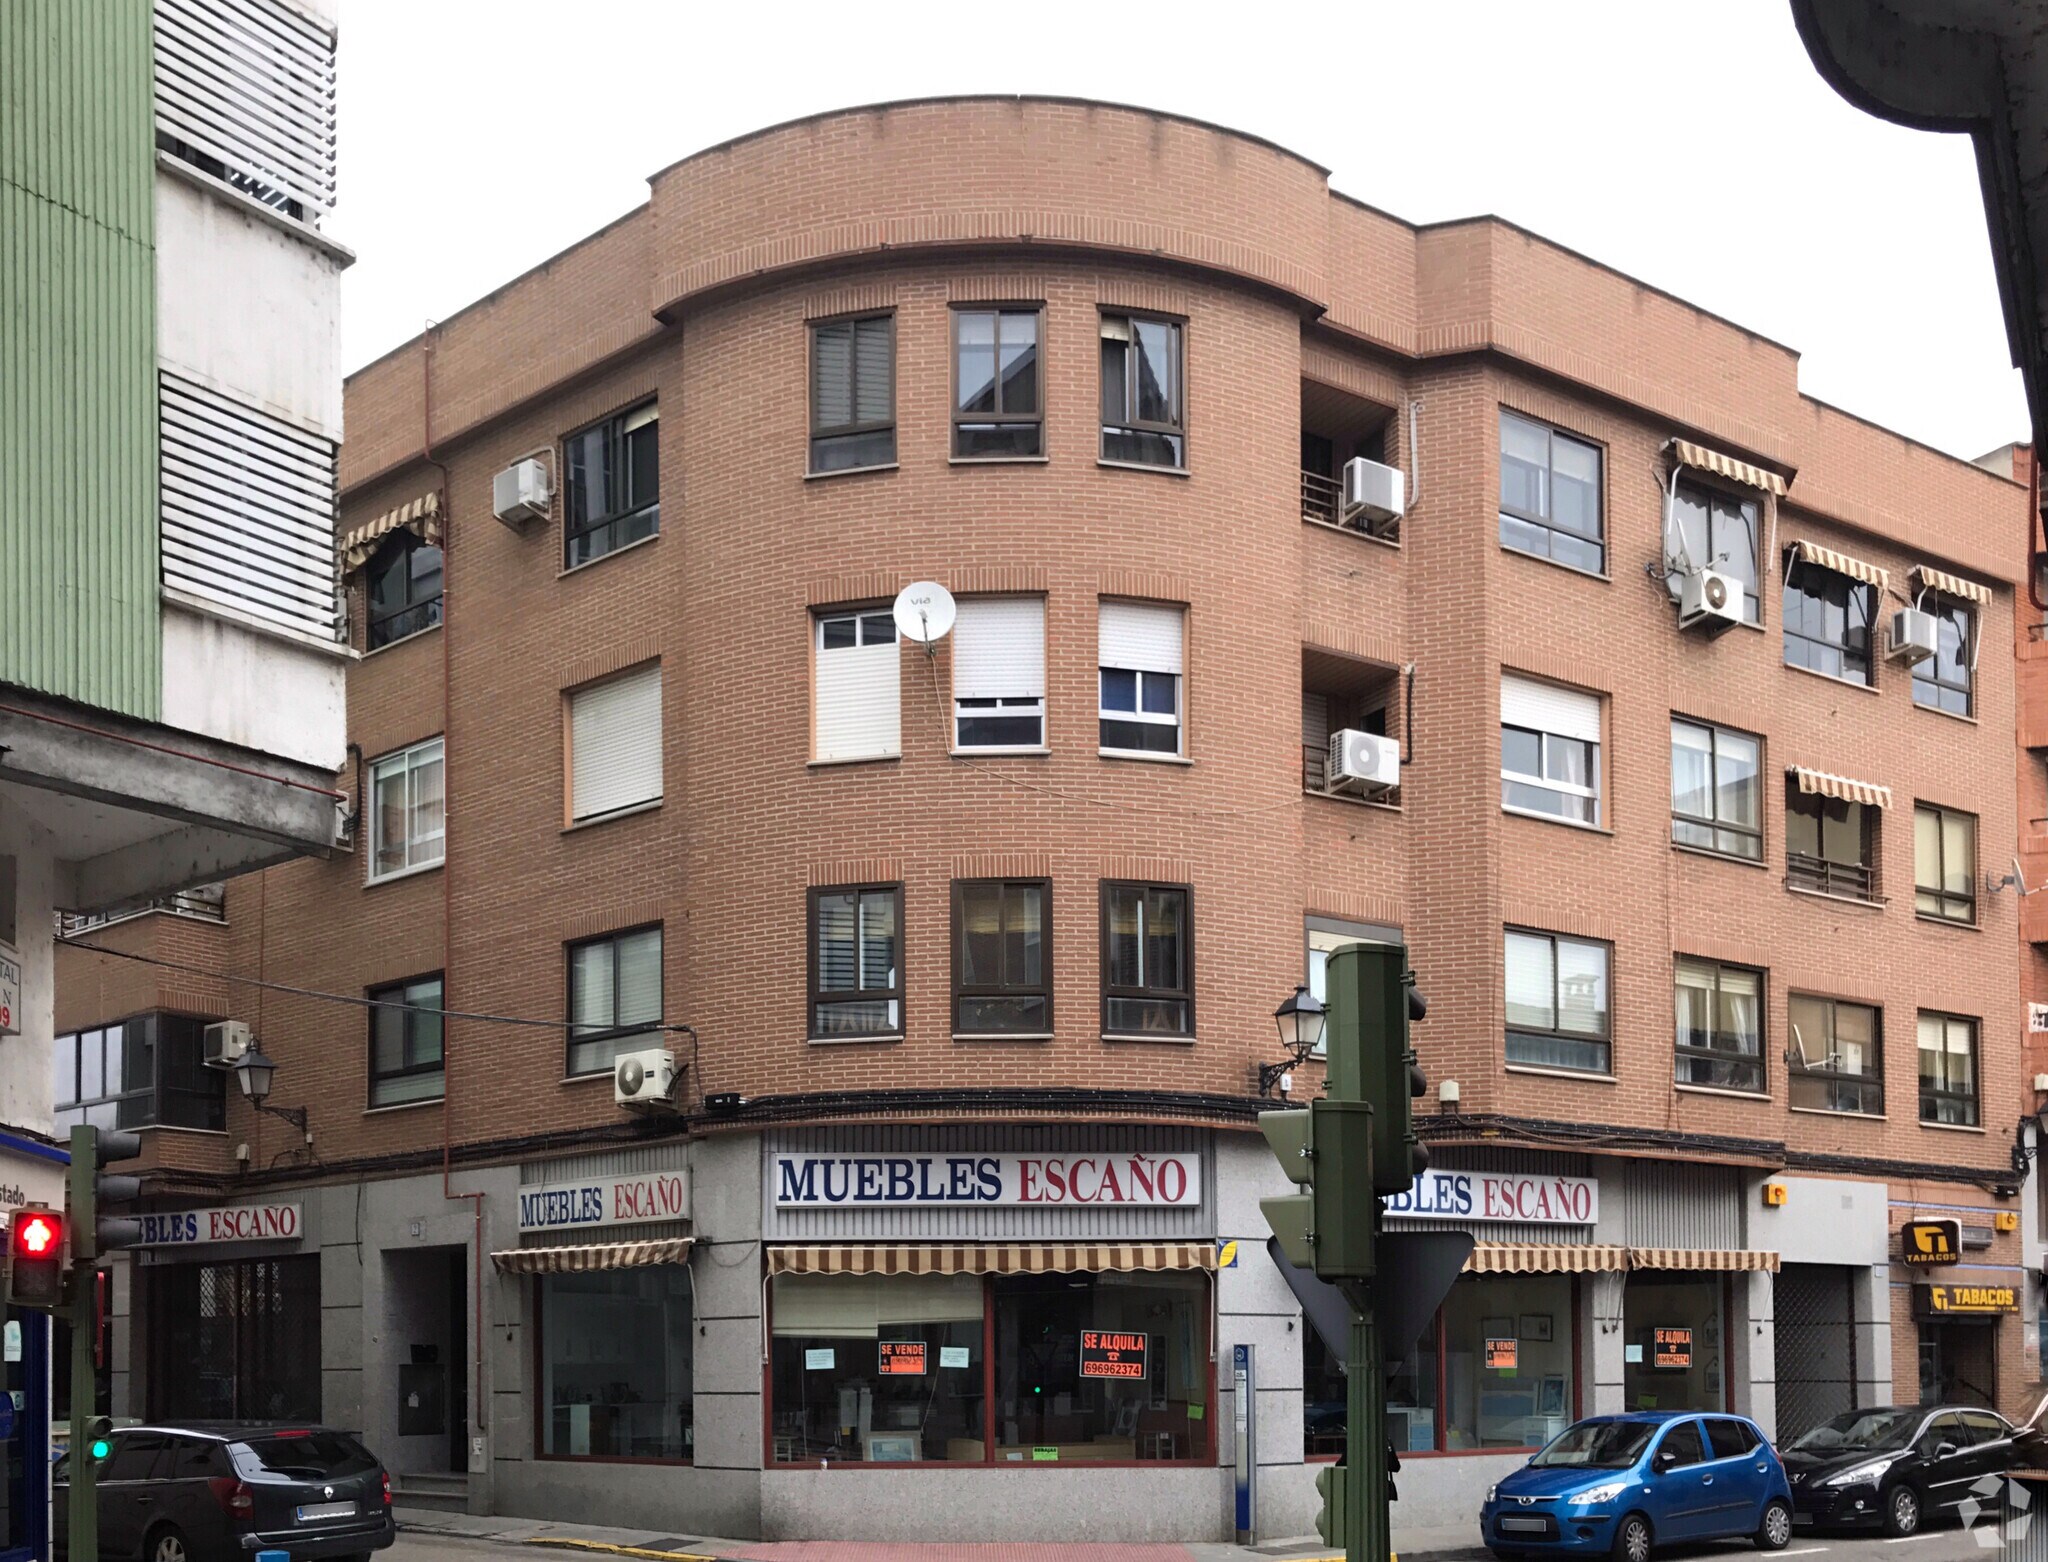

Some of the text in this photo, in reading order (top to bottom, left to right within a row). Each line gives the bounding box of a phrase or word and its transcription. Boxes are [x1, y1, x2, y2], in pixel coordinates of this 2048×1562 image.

[778, 1153, 1187, 1203] MUEBLES ESCAÑO
[520, 1175, 682, 1227] MUEBLES ESCAÑO
[1482, 1177, 1591, 1221] ESCAÑO
[208, 1205, 295, 1240] ESCAÑO
[1907, 1253, 1957, 1262] TABACOS
[1953, 1288, 2014, 1305] TABACOS
[1084, 1334, 1144, 1351] SE ALQUILA
[1487, 1341, 1515, 1350] SE VENDE
[1657, 1331, 1690, 1344] SE ALQUILA
[881, 1344, 924, 1355] SE VENDE
[1085, 1363, 1140, 1375] 696962374
